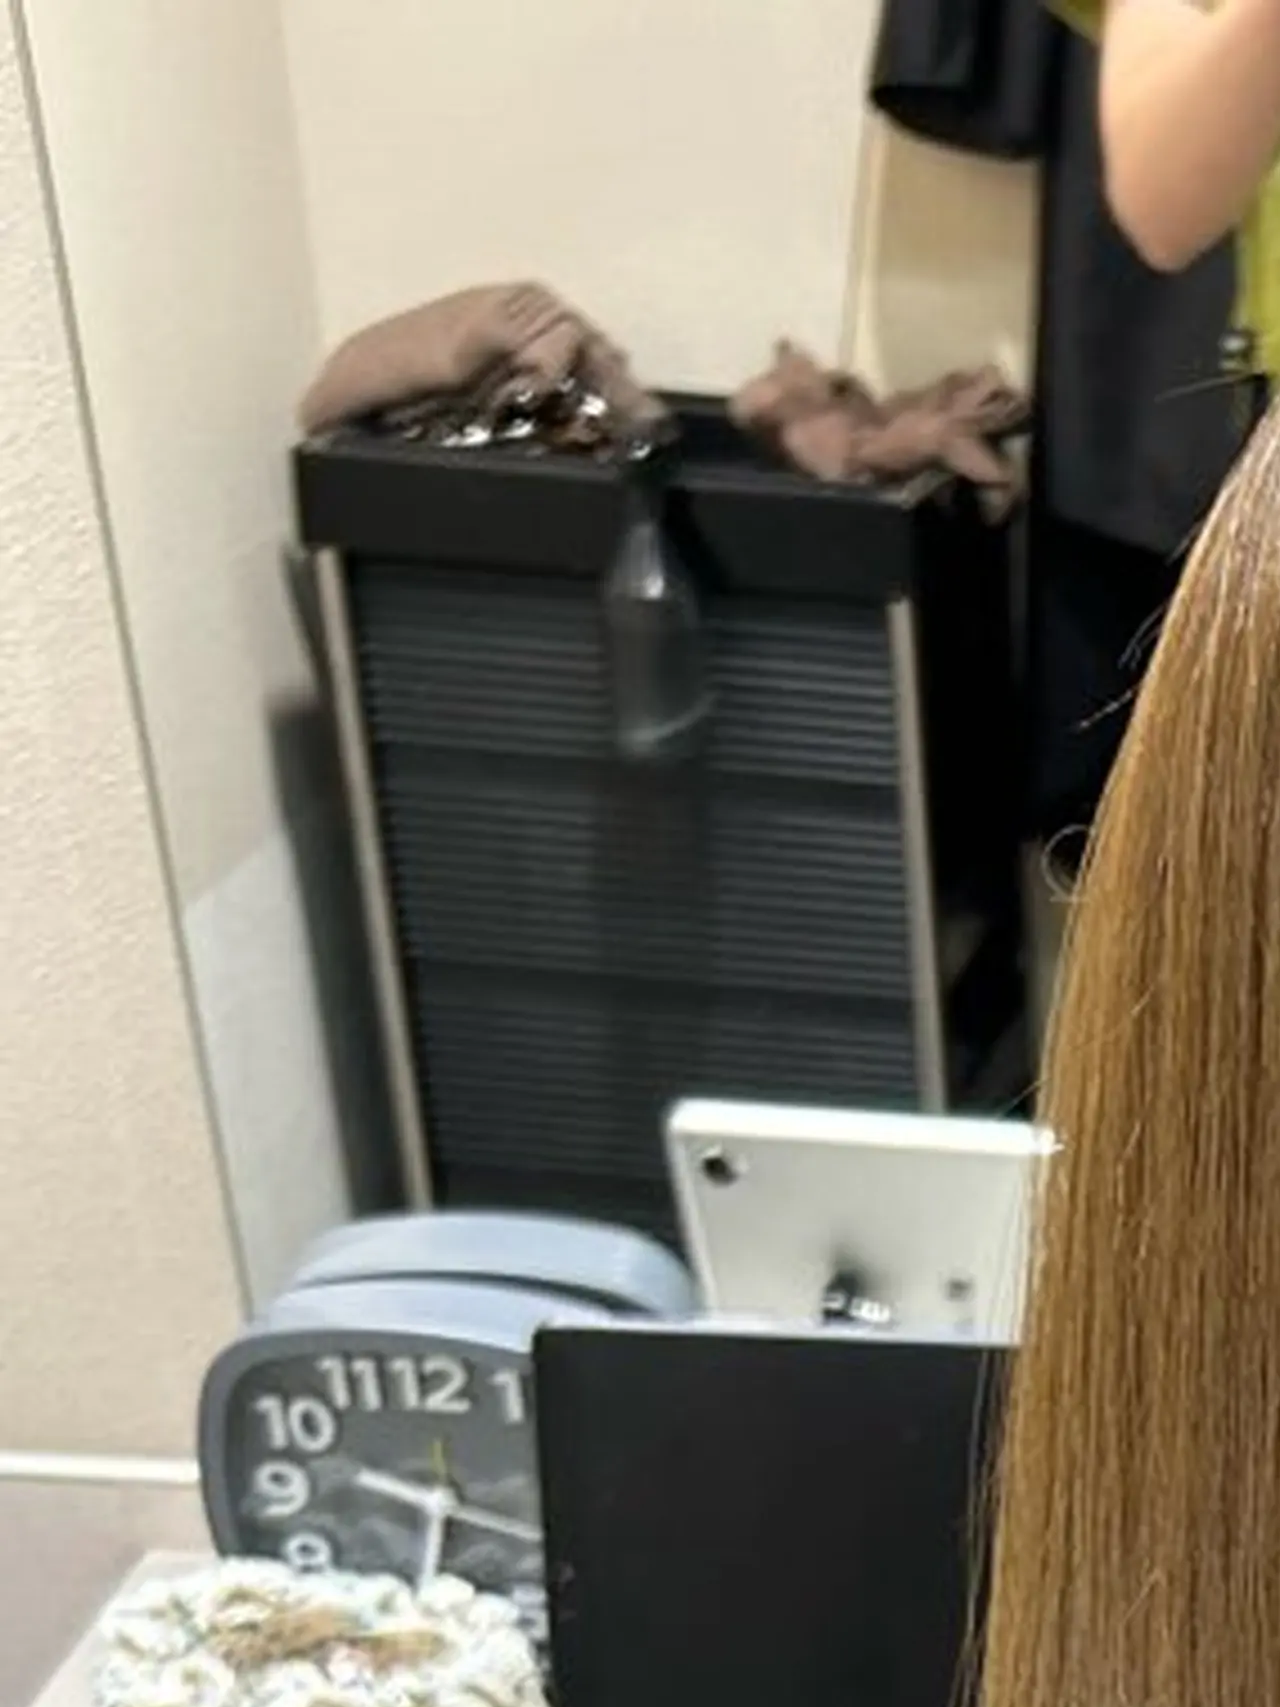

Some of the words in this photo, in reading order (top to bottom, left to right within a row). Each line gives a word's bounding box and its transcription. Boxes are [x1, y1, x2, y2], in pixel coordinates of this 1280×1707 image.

[317, 1357, 382, 1412] 11
[388, 1357, 471, 1414] 12
[490, 1369, 525, 1423] 1
[255, 1395, 336, 1452] 10
[254, 1461, 310, 1518] 9
